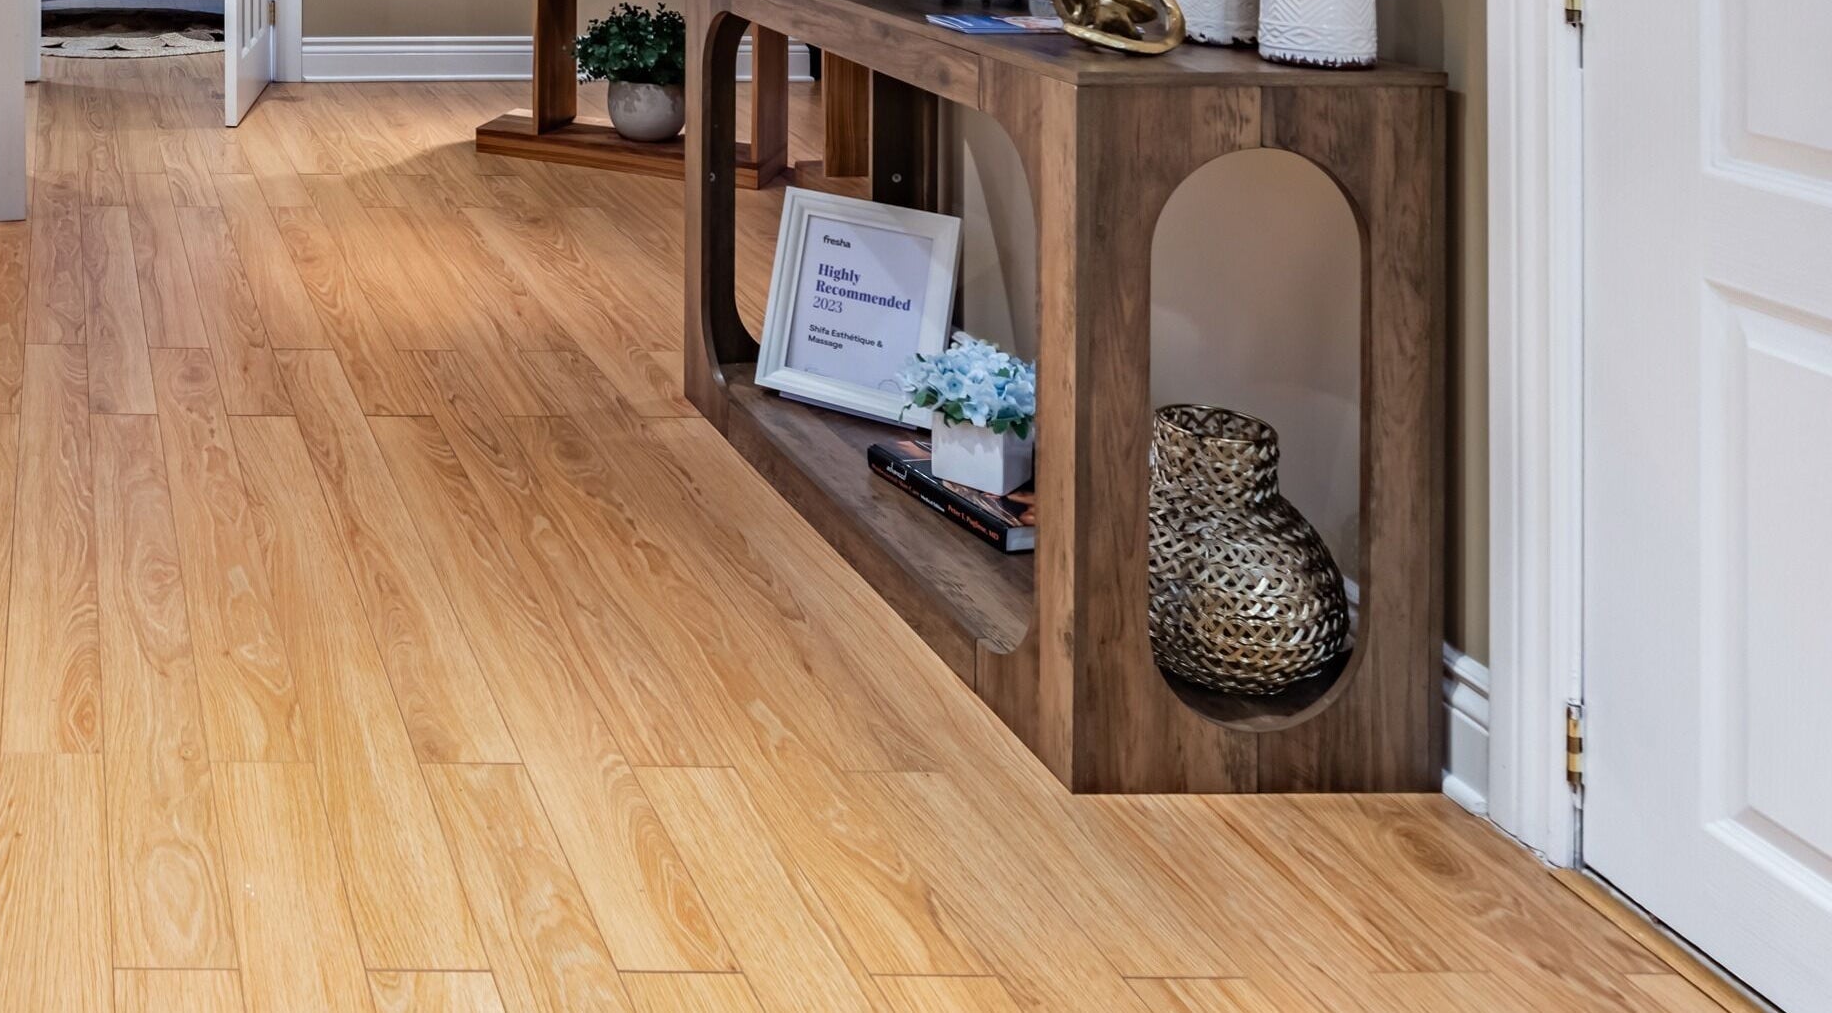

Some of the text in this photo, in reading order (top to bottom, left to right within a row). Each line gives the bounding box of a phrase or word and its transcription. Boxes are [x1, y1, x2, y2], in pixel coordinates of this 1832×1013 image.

[823, 235, 851, 248] fresha
[818, 263, 861, 285] Highly
[813, 296, 843, 313] 2023
[816, 279, 912, 311] Recommended
[808, 335, 843, 349] Massage
[809, 324, 883, 348] Shifa Esthétique &
